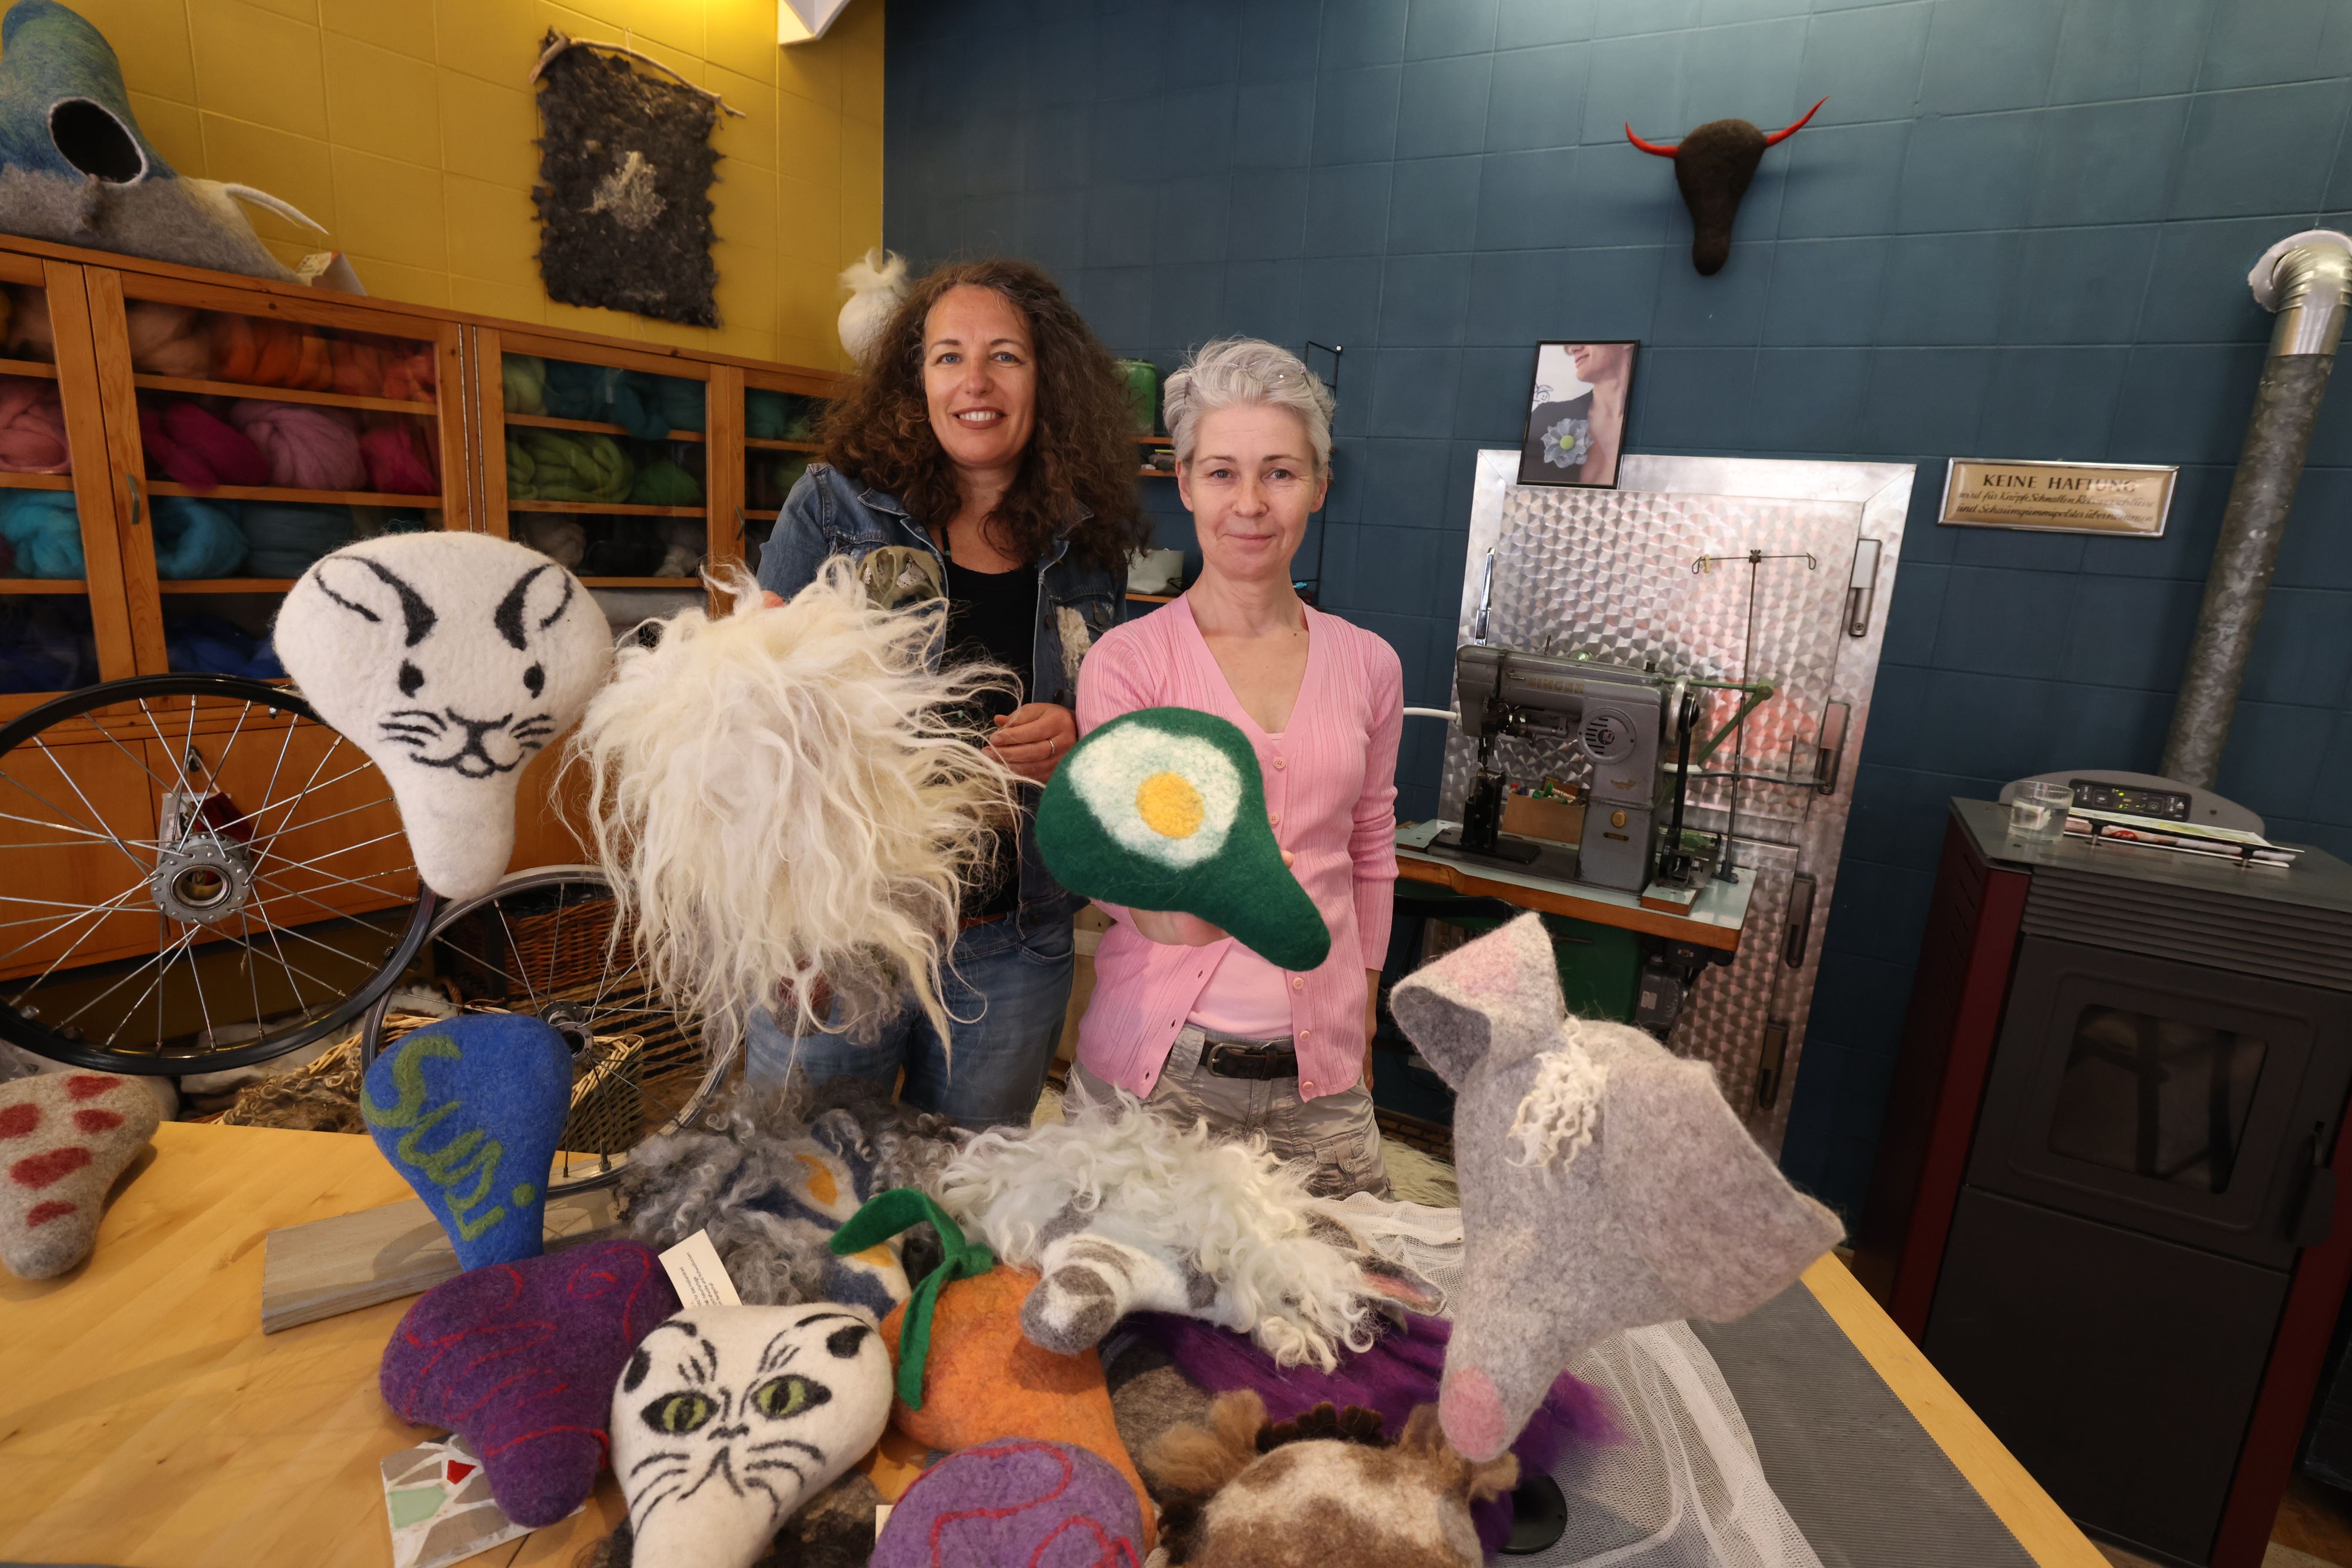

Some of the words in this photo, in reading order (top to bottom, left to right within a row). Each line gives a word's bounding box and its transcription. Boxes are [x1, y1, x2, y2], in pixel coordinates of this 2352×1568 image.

[1983, 474, 2038, 488] KEINE
[2048, 477, 2136, 493] HAFTUNG
[1982, 490, 1998, 503] für
[1528, 677, 1585, 694] SINGER
